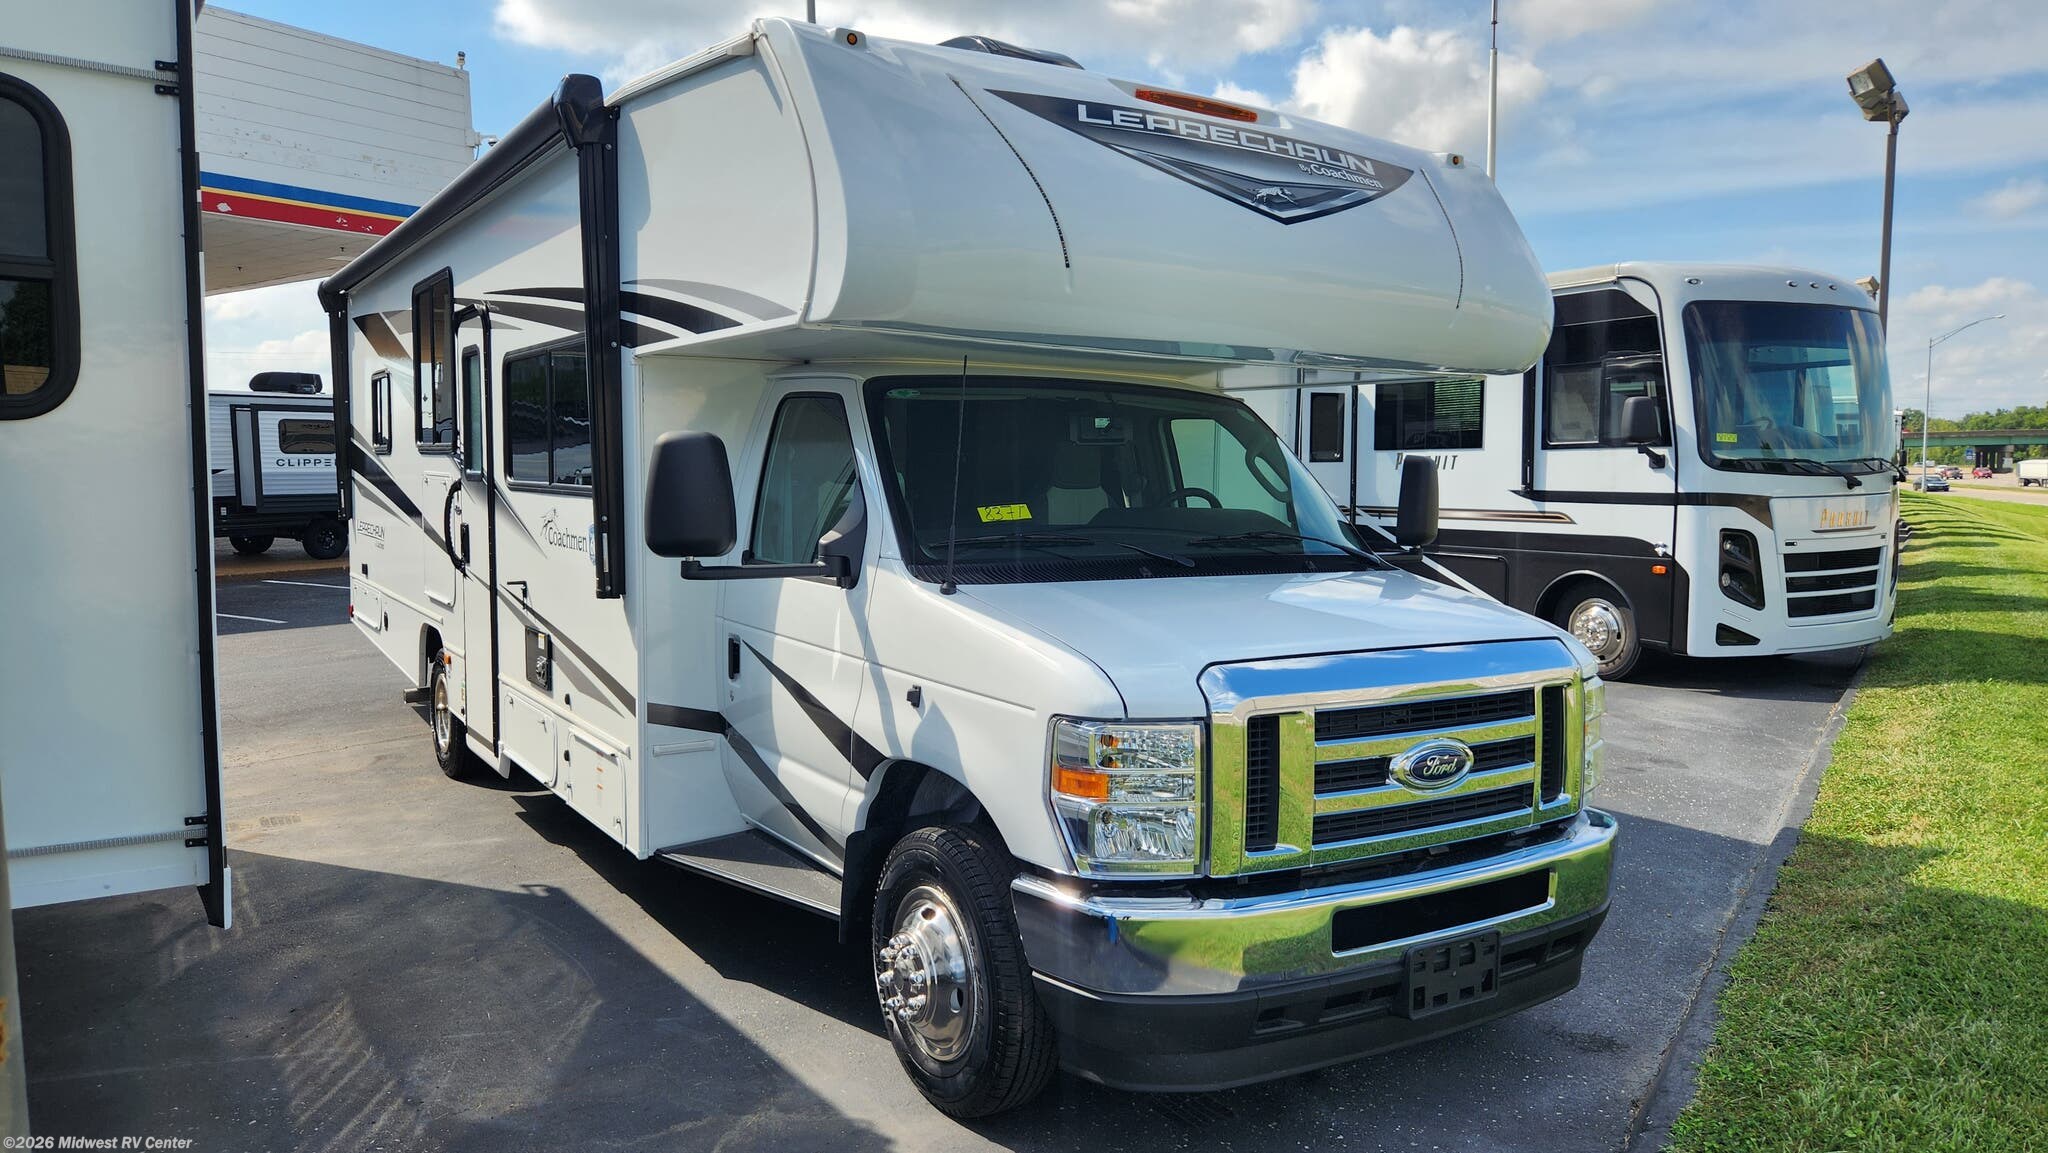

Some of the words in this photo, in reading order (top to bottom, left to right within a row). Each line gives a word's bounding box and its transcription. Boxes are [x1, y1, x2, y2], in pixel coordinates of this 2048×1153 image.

[1077, 103, 1376, 176] LEPRECHAUN
[1310, 163, 1384, 189] Coachmen
[275, 458, 337, 467] CLIPPE
[1395, 452, 1458, 470] PUIT
[547, 526, 588, 552] Coachmen
[1423, 754, 1458, 777] Ford
